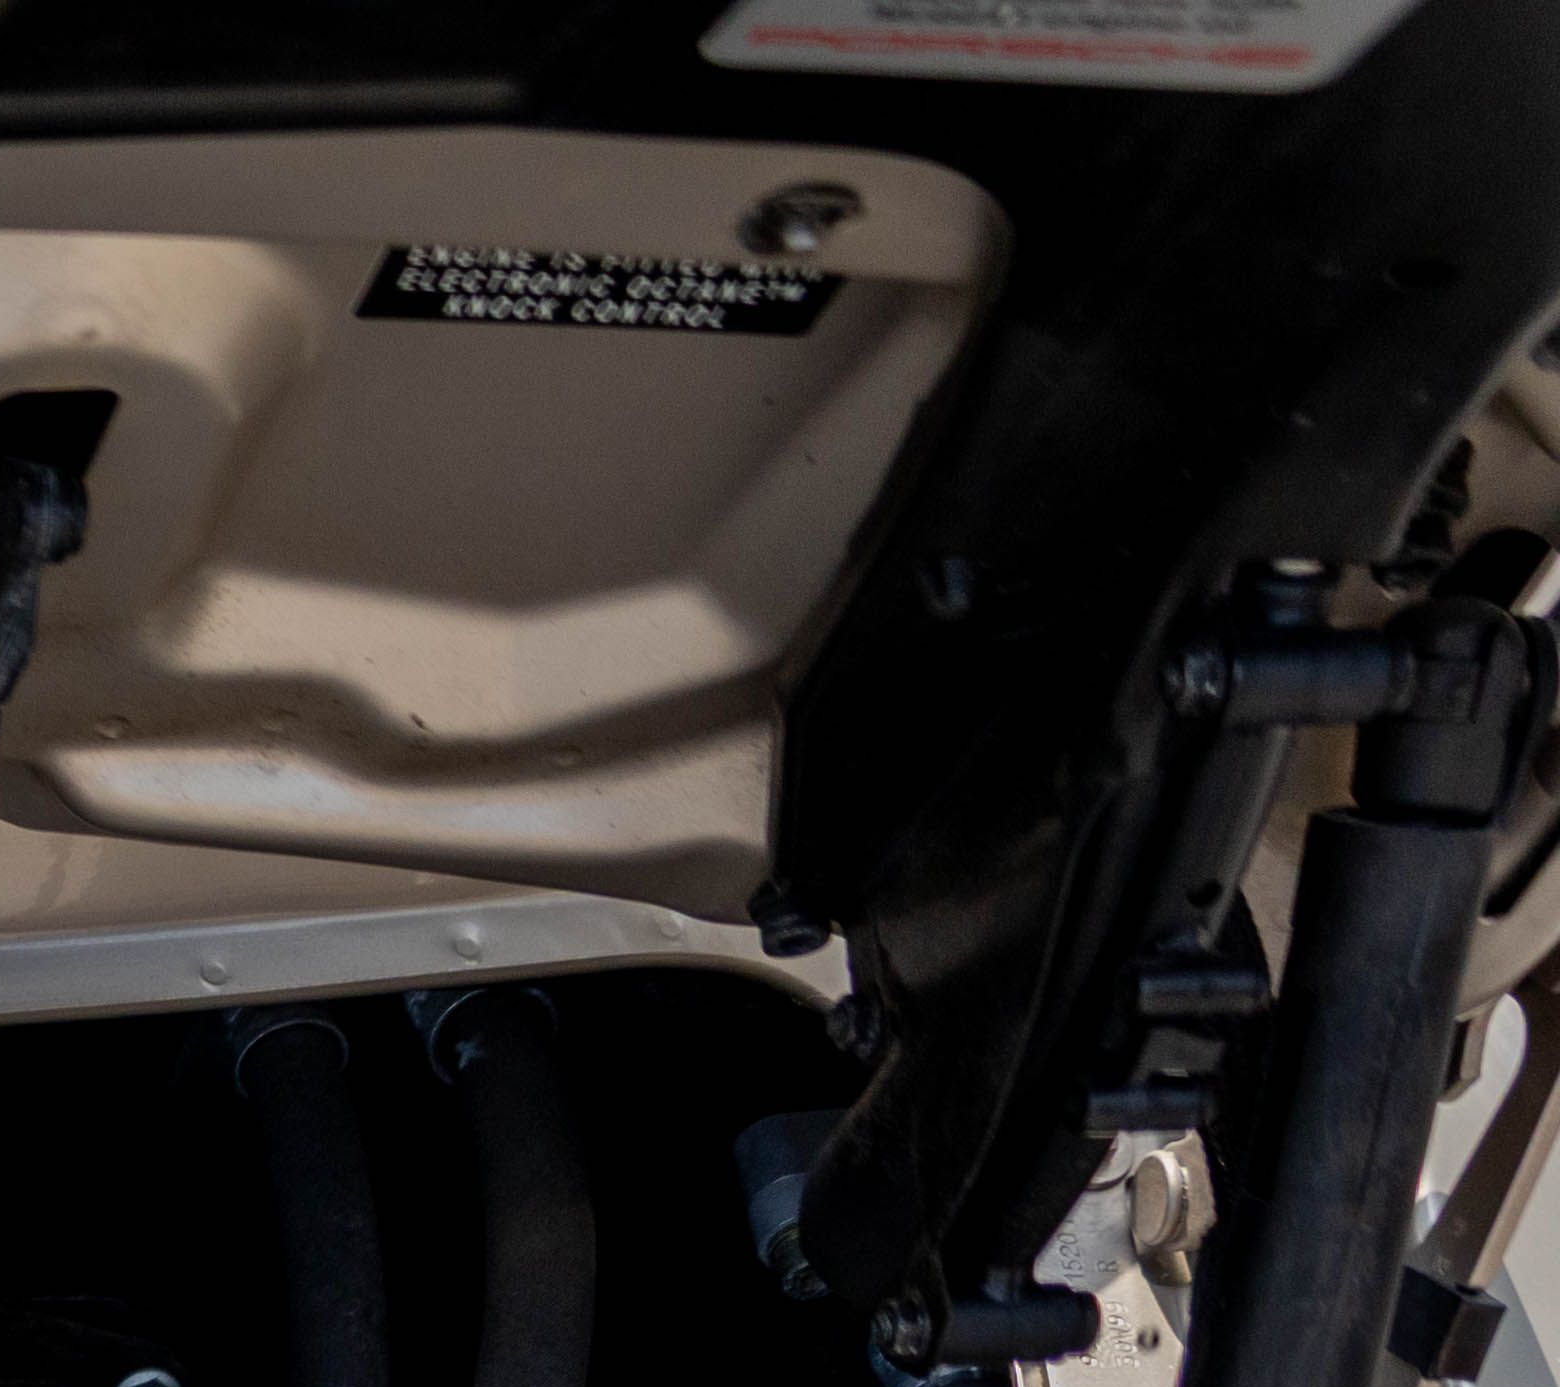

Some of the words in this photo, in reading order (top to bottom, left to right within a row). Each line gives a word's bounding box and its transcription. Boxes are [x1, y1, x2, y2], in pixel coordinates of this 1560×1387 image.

[395, 266, 616, 299] ELECTRONIC
[441, 294, 560, 321] KNOCK
[570, 298, 727, 330] CONTROL
